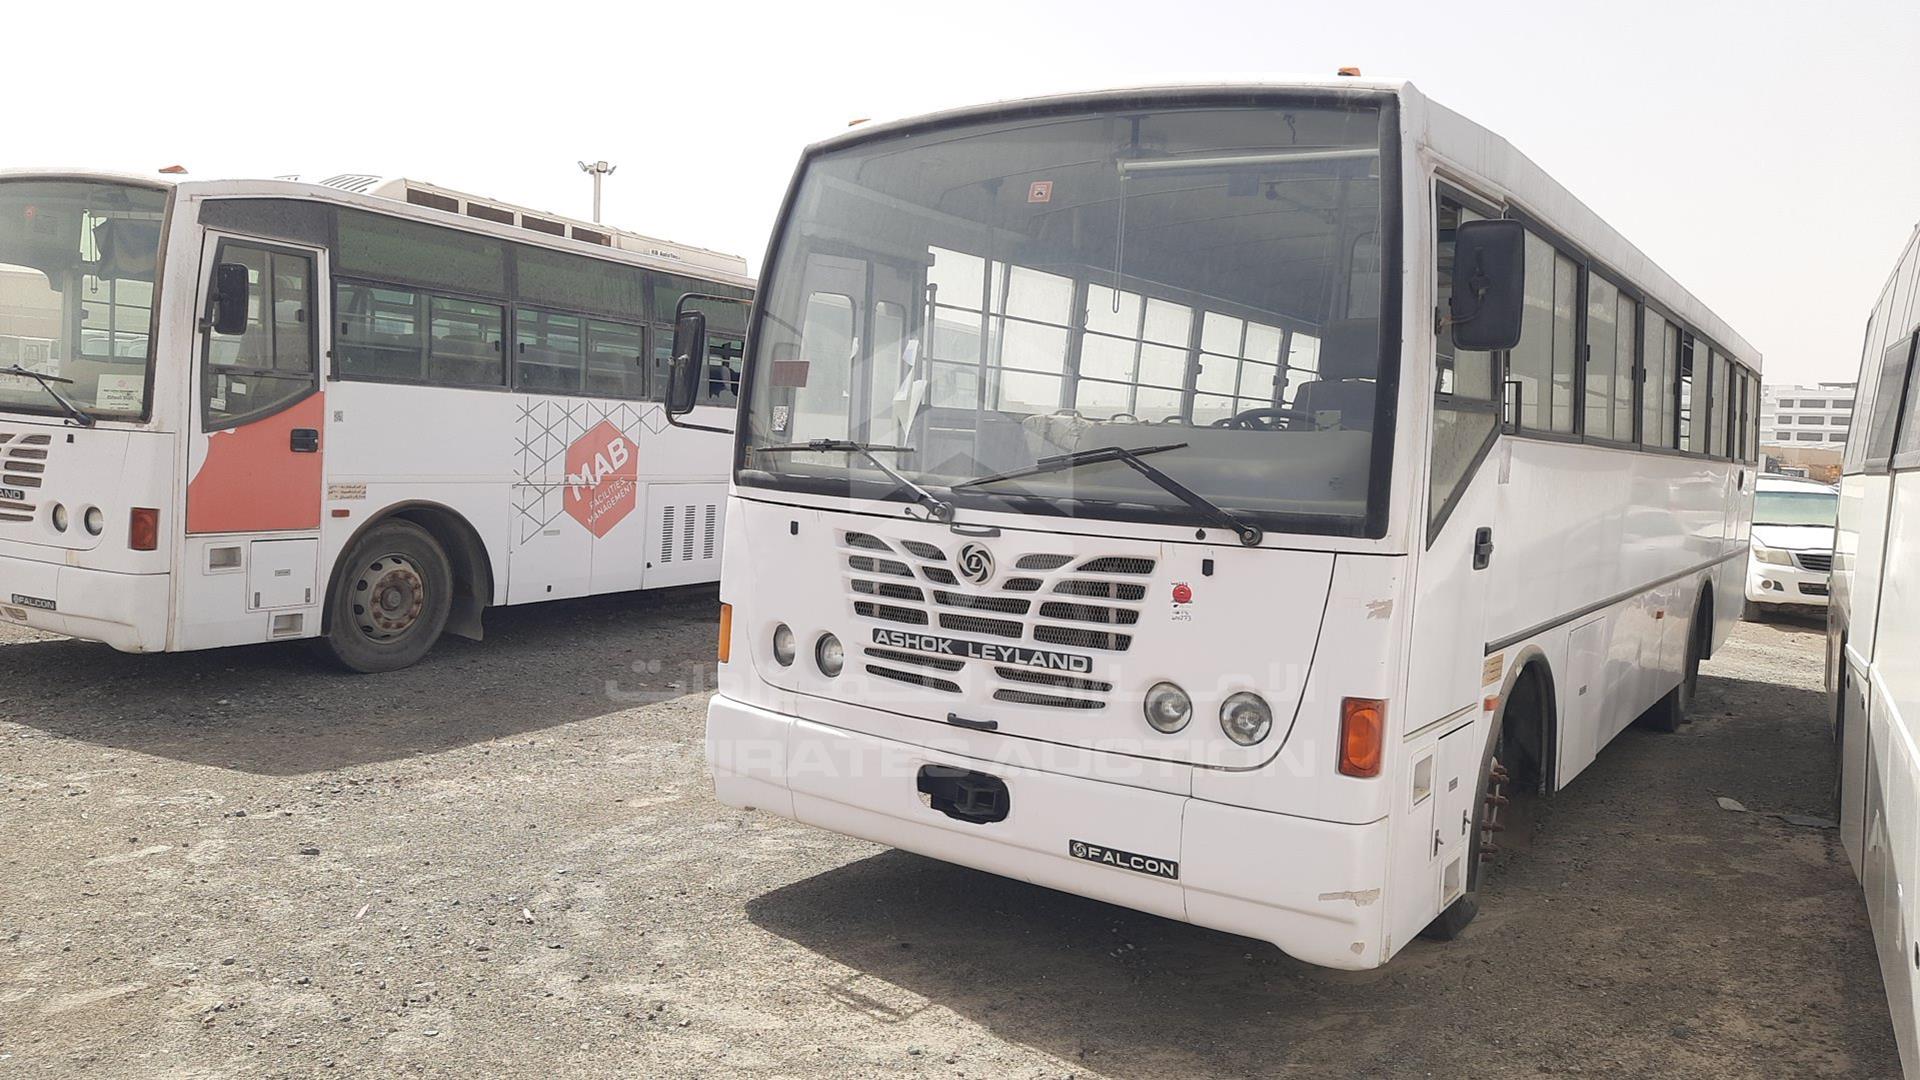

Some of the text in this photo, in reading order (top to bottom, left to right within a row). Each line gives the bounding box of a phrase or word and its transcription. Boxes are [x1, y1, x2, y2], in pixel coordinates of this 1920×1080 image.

[569, 437, 628, 501] MAB
[587, 481, 634, 525] MANAGEMENT
[589, 477, 625, 509] FACILITIES
[19, 596, 54, 609] FALCON
[875, 630, 1089, 672] ASHOK LEYLAND
[1088, 846, 1174, 876] FALCON
